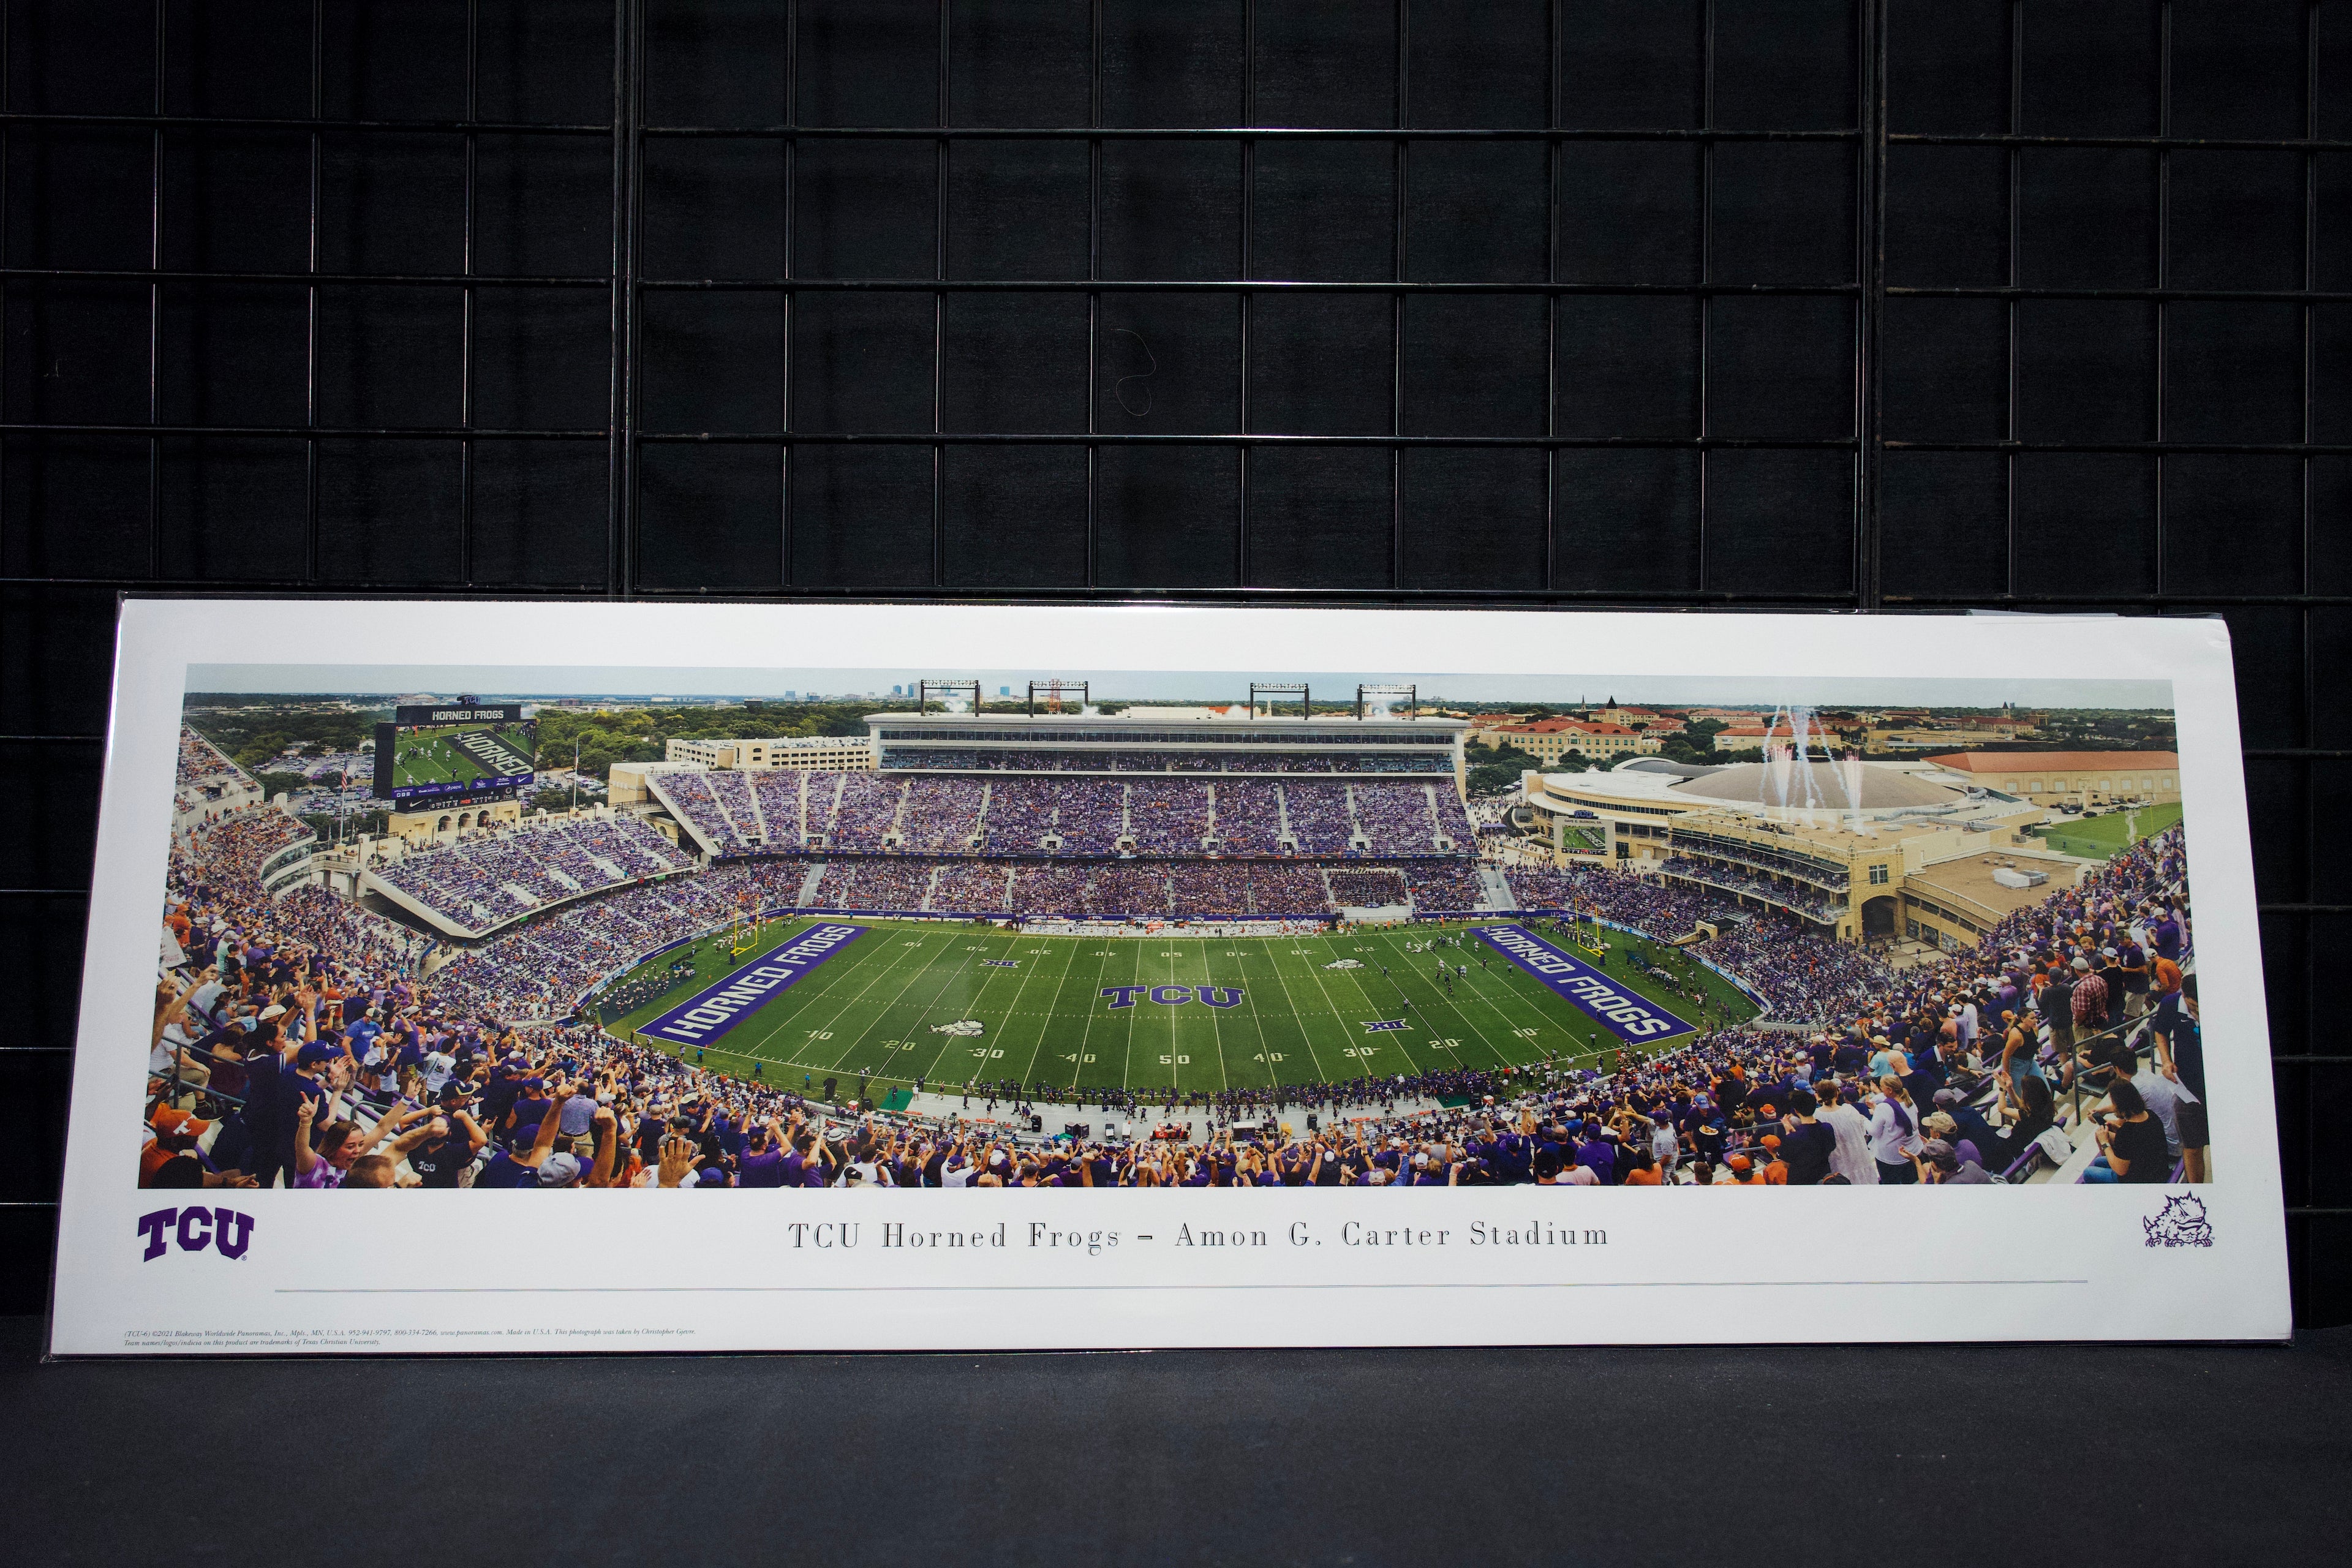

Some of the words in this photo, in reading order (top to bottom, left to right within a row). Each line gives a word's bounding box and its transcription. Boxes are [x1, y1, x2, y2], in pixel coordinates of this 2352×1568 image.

[432, 711, 472, 721] HORNED
[474, 710, 504, 720] FROGS
[1631, 929, 1648, 938] GEICO
[661, 966, 794, 1039] HORNED
[773, 925, 856, 965] FROGS
[1481, 927, 1576, 974] HORNED
[1557, 976, 1671, 1035] FROGS
[1099, 985, 1246, 1009] TCU
[808, 1030, 834, 1040] 10
[1512, 1028, 1537, 1038] 10
[884, 1039, 917, 1050] 20
[1428, 1038, 1460, 1049] 20
[973, 1048, 1005, 1059] 30
[1253, 1052, 1284, 1063] 40
[1343, 1047, 1374, 1057] 30
[1065, 1053, 1097, 1063] 40
[1159, 1055, 1190, 1065] 50
[418, 1161, 436, 1172] TCU
[138, 1206, 255, 1262] TCU
[788, 1223, 861, 1248] TCU
[881, 1223, 1006, 1248] Horned
[1028, 1223, 1120, 1256] Frogs
[1174, 1223, 1268, 1246] Amon
[1288, 1222, 1321, 1246] G.
[1341, 1221, 1450, 1246] Carter
[1470, 1221, 1608, 1245] Stadium
